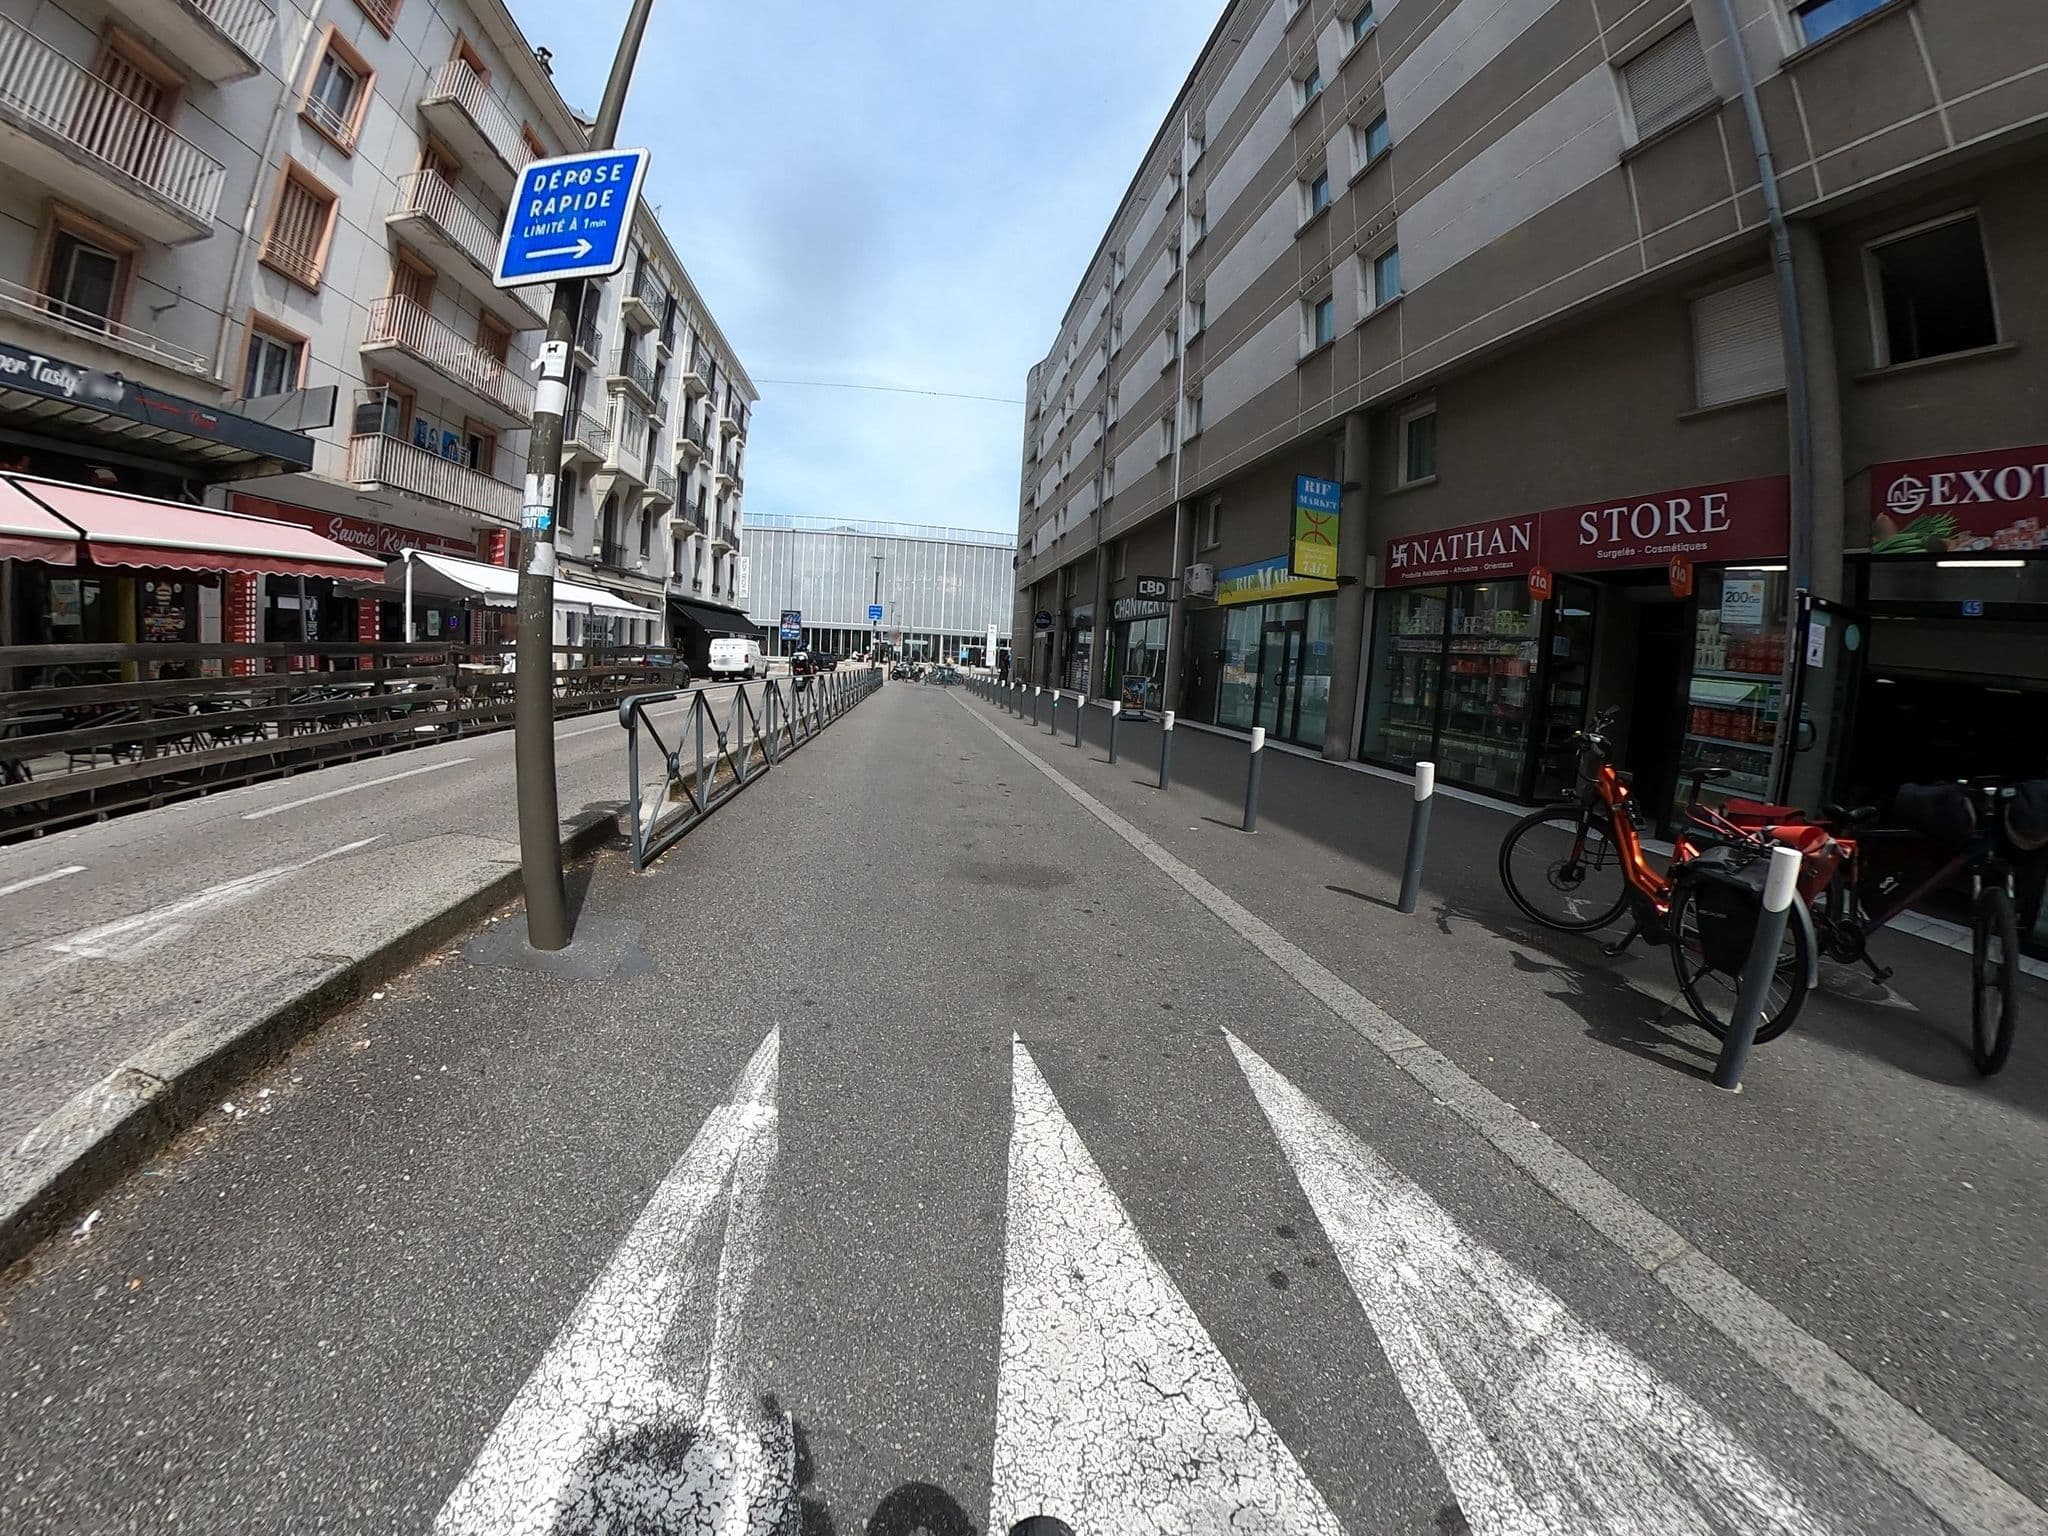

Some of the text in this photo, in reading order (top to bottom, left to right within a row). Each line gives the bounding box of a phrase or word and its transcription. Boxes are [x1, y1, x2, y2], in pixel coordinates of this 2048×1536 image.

[534, 164, 624, 192] DÉPOSE
[530, 190, 613, 218] RAPIDE
[524, 219, 565, 238] LIMITÉ
[1305, 480, 1331, 495] RIF
[1300, 495, 1337, 509] MARKET
[1579, 492, 1732, 545] STORE
[328, 517, 377, 547] Savoie
[1412, 522, 1533, 566] NATHAN
[1597, 542, 1708, 560] Surgelés Cosmétiques
[1530, 571, 1547, 589] ria
[1671, 560, 1686, 582] ria
[1140, 581, 1165, 595] CBD
[1236, 575, 1255, 591] RIF
